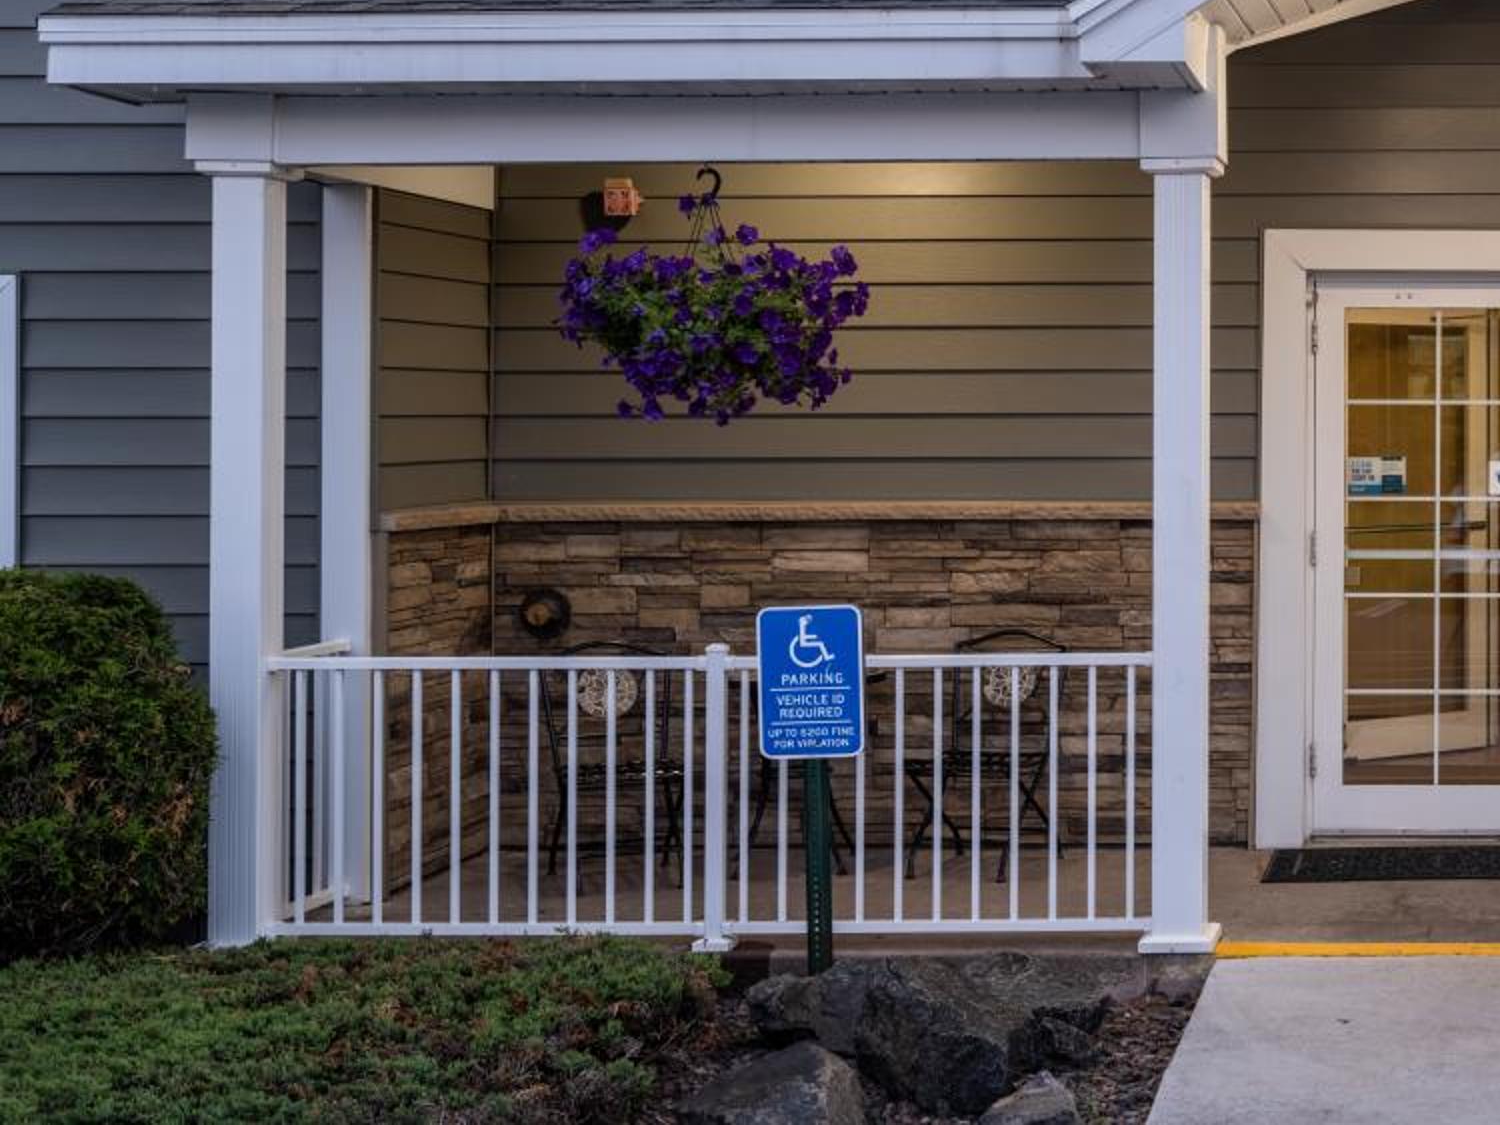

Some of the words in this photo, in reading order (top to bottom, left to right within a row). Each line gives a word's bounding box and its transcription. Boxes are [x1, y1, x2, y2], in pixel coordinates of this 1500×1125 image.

[781, 673, 843, 685] PARKING
[776, 695, 828, 705] VEHICLE
[780, 707, 843, 718] REQUIRED
[768, 729, 782, 737] UP
[785, 728, 798, 737] TO
